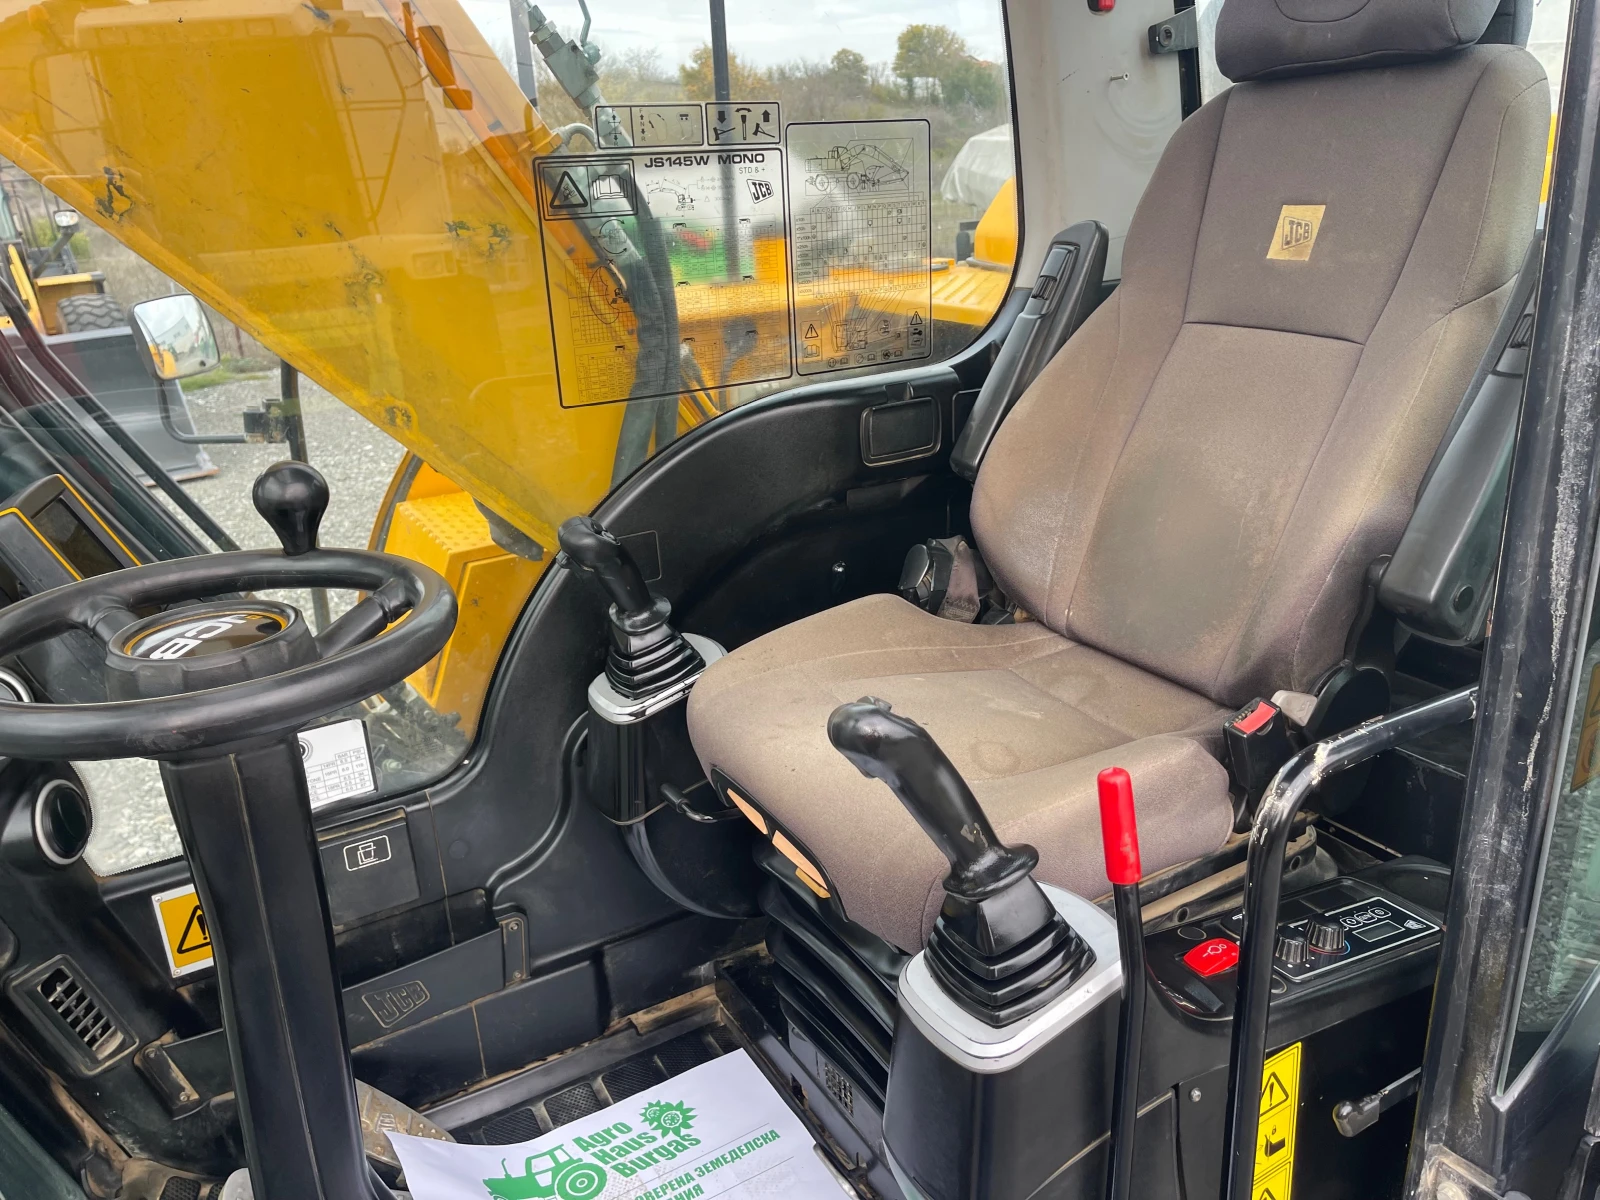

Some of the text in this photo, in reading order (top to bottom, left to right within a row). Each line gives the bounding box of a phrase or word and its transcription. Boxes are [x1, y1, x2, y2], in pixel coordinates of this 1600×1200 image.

[644, 153, 765, 168] JS145W MONO
[739, 166, 753, 174] STD
[751, 181, 773, 201] JCB
[1284, 220, 1310, 246] JCB
[149, 614, 248, 660] JCB
[373, 984, 427, 1023] JCB
[572, 1121, 633, 1153] Agro
[589, 1131, 658, 1166] Haus
[694, 1129, 781, 1178] ЗЕМЕДЕЛСКА
[610, 1133, 702, 1178] Burgas
